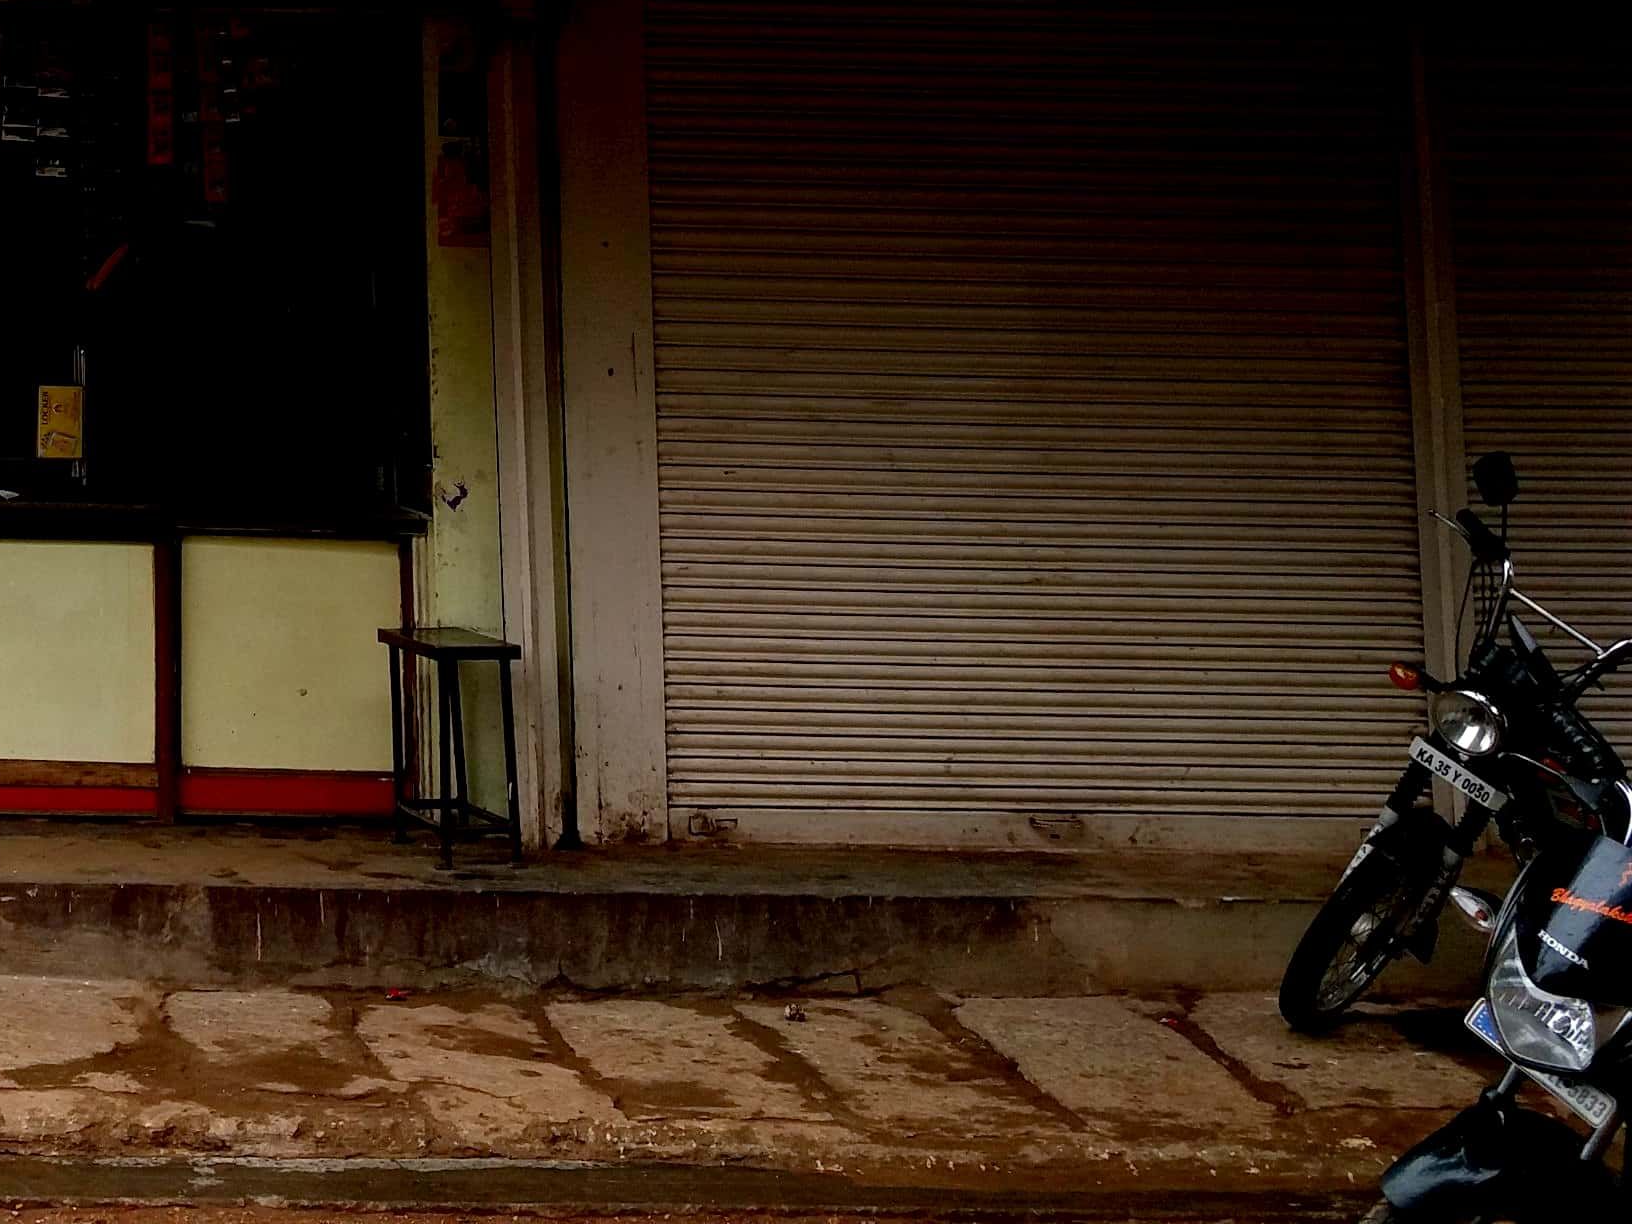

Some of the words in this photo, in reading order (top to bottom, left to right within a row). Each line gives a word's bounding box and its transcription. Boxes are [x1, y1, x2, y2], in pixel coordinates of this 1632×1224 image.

[1415, 747, 1434, 767] KA
[1434, 760, 1452, 777] 35
[1452, 770, 1462, 784] Y
[1537, 928, 1589, 970] HONDA
